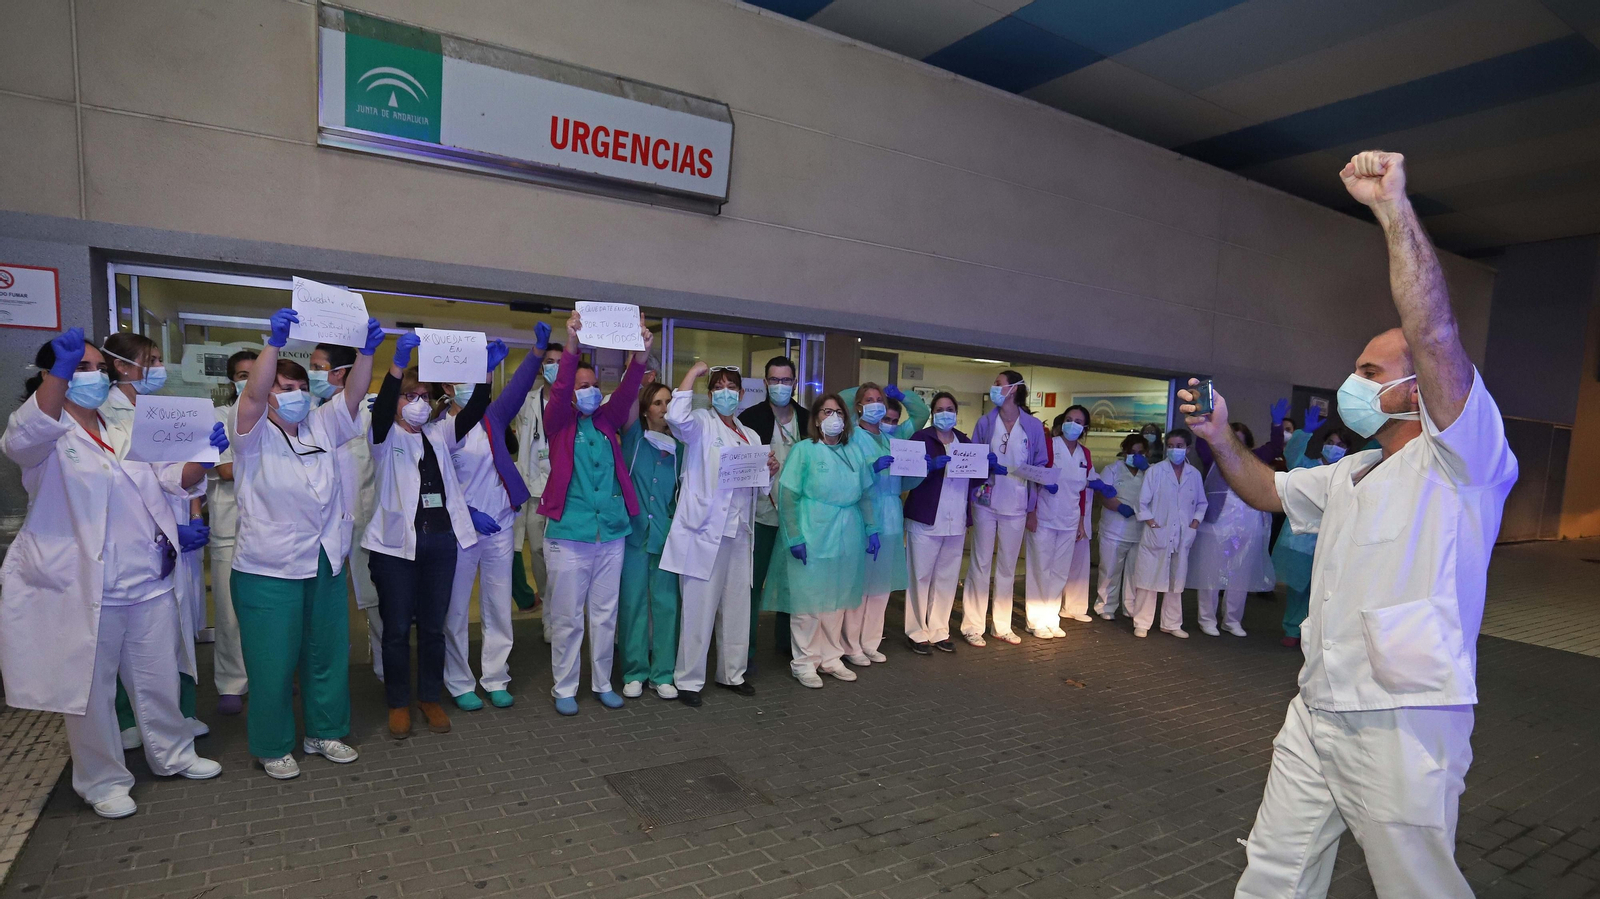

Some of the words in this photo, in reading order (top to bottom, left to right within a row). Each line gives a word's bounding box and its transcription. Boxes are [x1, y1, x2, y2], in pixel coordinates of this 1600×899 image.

[356, 104, 378, 116] JUNTA
[381, 108, 390, 119] DE
[550, 114, 713, 179] URGENCIAS
[584, 320, 598, 328] POR
[599, 320, 610, 328] TU
[449, 345, 463, 354] EN
[432, 355, 468, 365] CASA
[910, 370, 916, 378] 2
[173, 421, 187, 429] EN
[152, 429, 194, 443] CASA
